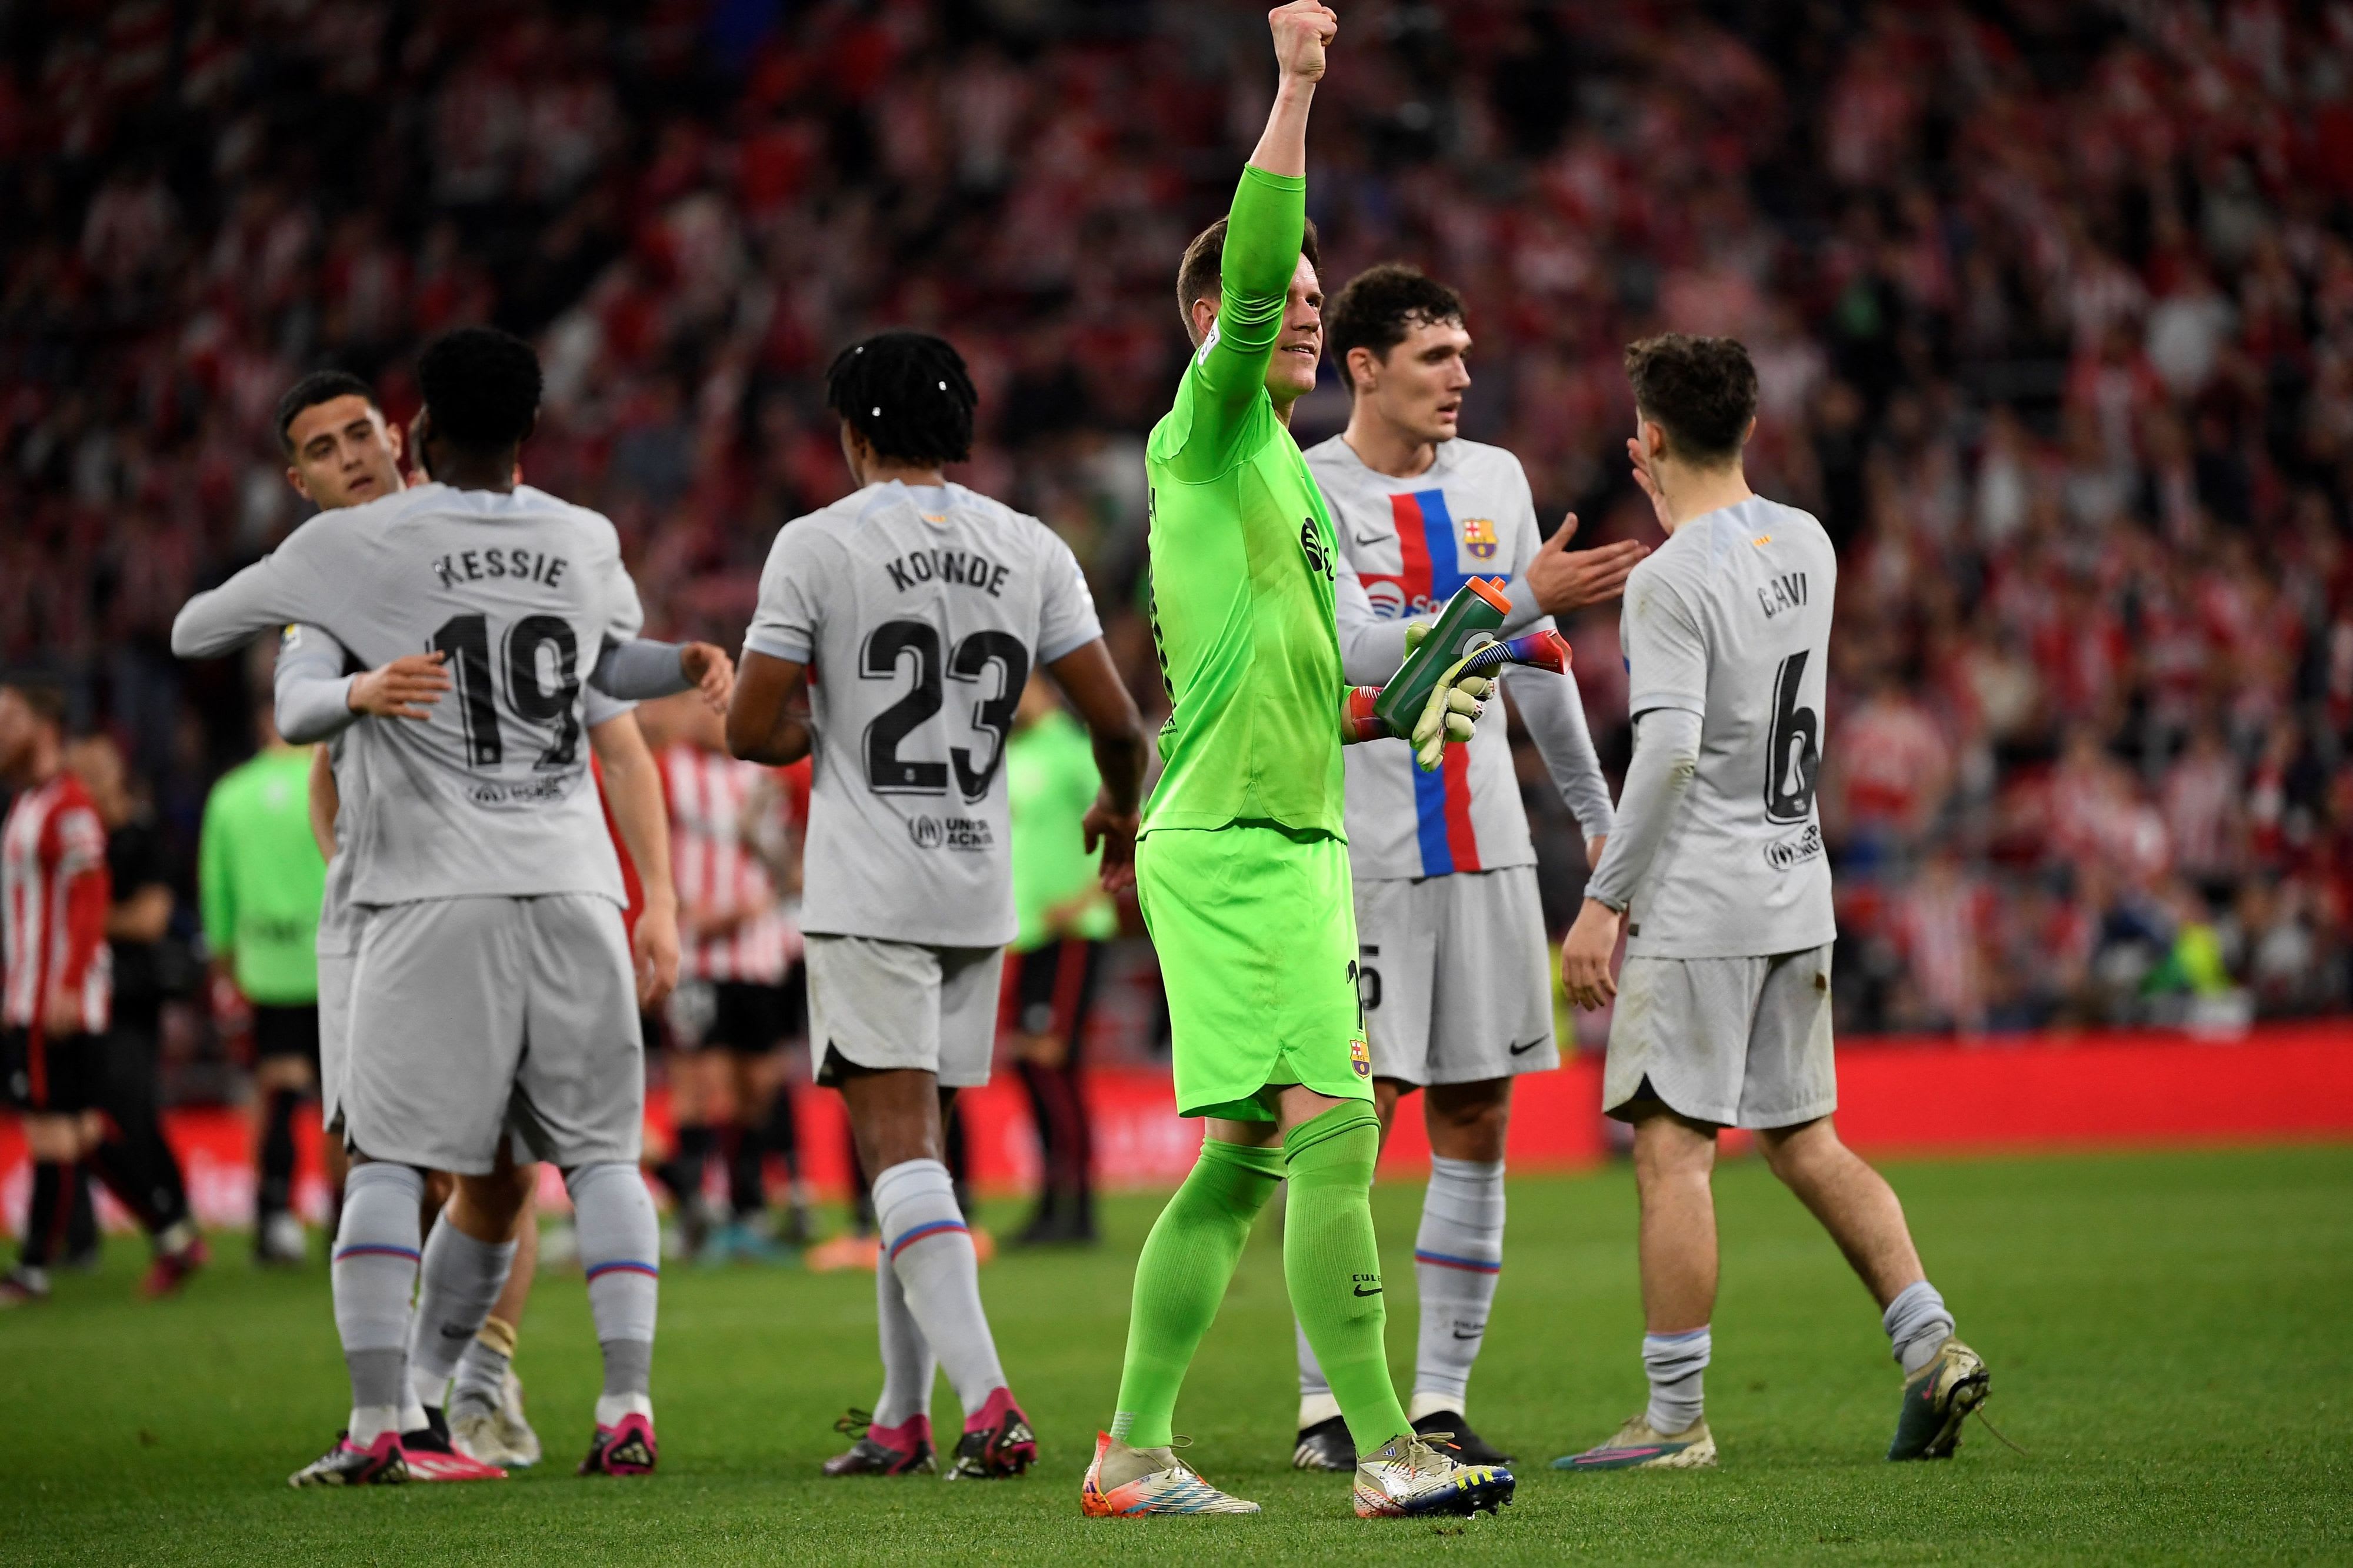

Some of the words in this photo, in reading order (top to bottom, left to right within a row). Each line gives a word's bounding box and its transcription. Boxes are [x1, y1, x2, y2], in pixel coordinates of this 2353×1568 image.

[435, 548, 568, 588] KESSIE
[1758, 572, 1807, 619] GAVI
[426, 613, 580, 770] 19
[859, 620, 1028, 805] 23
[1764, 648, 1821, 823] 6
